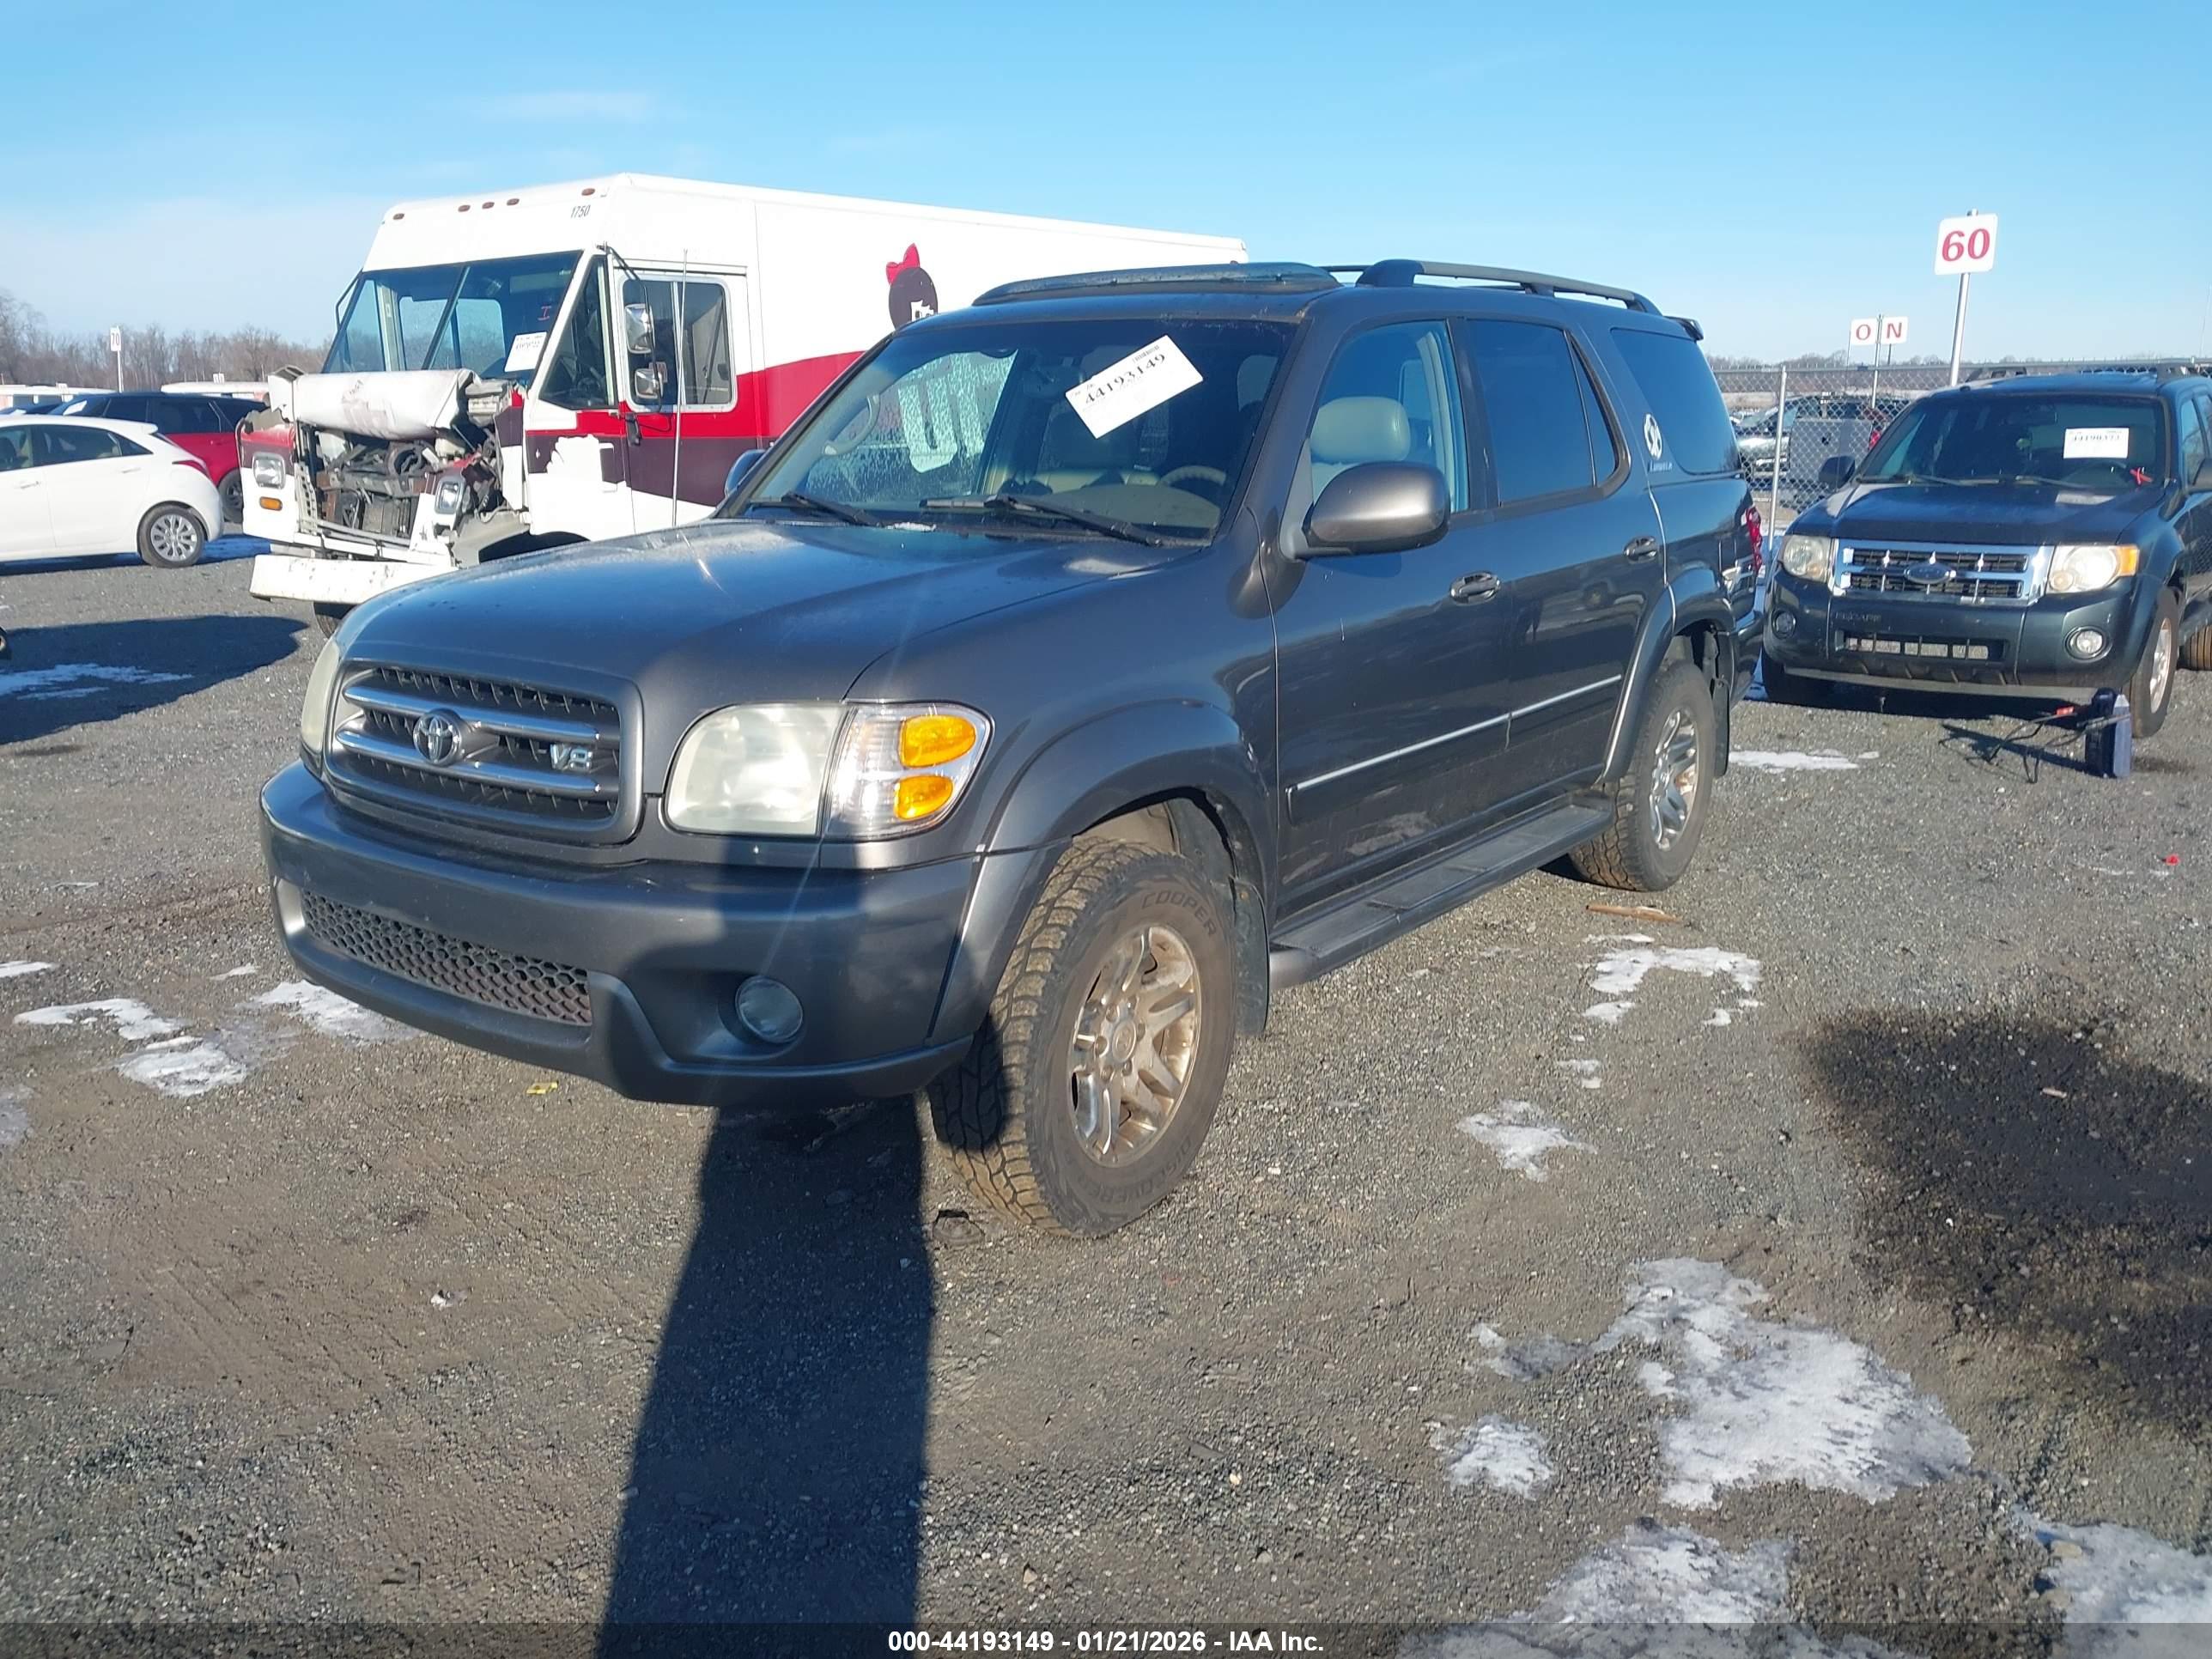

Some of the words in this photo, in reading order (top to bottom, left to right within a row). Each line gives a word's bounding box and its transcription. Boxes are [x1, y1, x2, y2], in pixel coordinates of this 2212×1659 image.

[570, 204, 591, 219] 1750
[1942, 228, 1990, 262] 60
[111, 332, 119, 346] 70
[1856, 324, 1871, 341] O
[1886, 322, 1903, 339] N
[1085, 353, 1165, 404] 44193149
[550, 744, 592, 771] V8
[1141, 890, 1217, 936] COOPER
